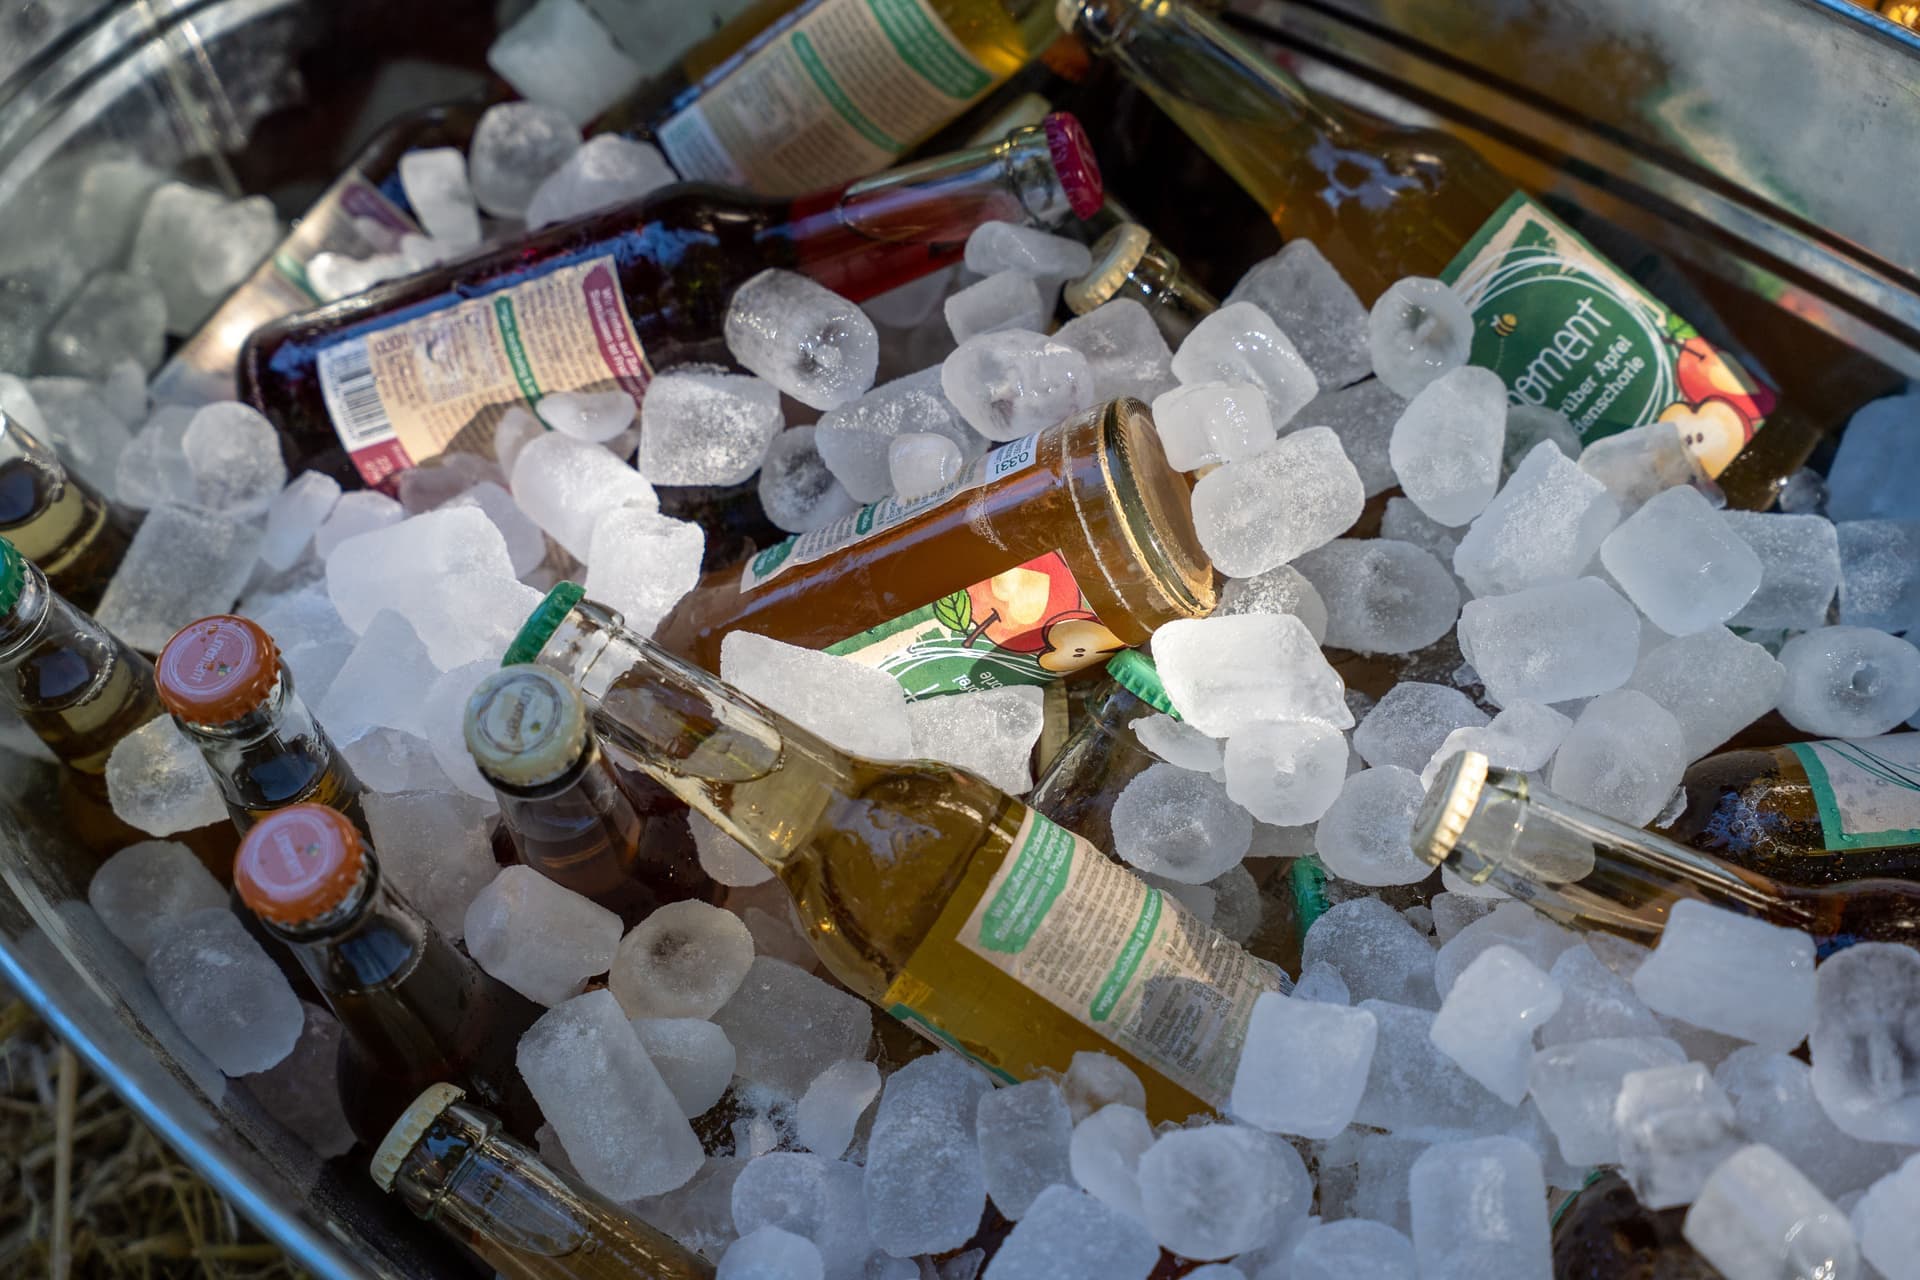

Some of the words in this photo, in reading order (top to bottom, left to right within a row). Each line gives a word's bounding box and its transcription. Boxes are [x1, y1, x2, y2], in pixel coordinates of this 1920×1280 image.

[1557, 374, 1598, 419] rüber
[1592, 333, 1633, 376] Apfel
[1571, 354, 1646, 434] denschorle
[951, 673, 984, 692] pfel
[979, 672, 1002, 689] orle
